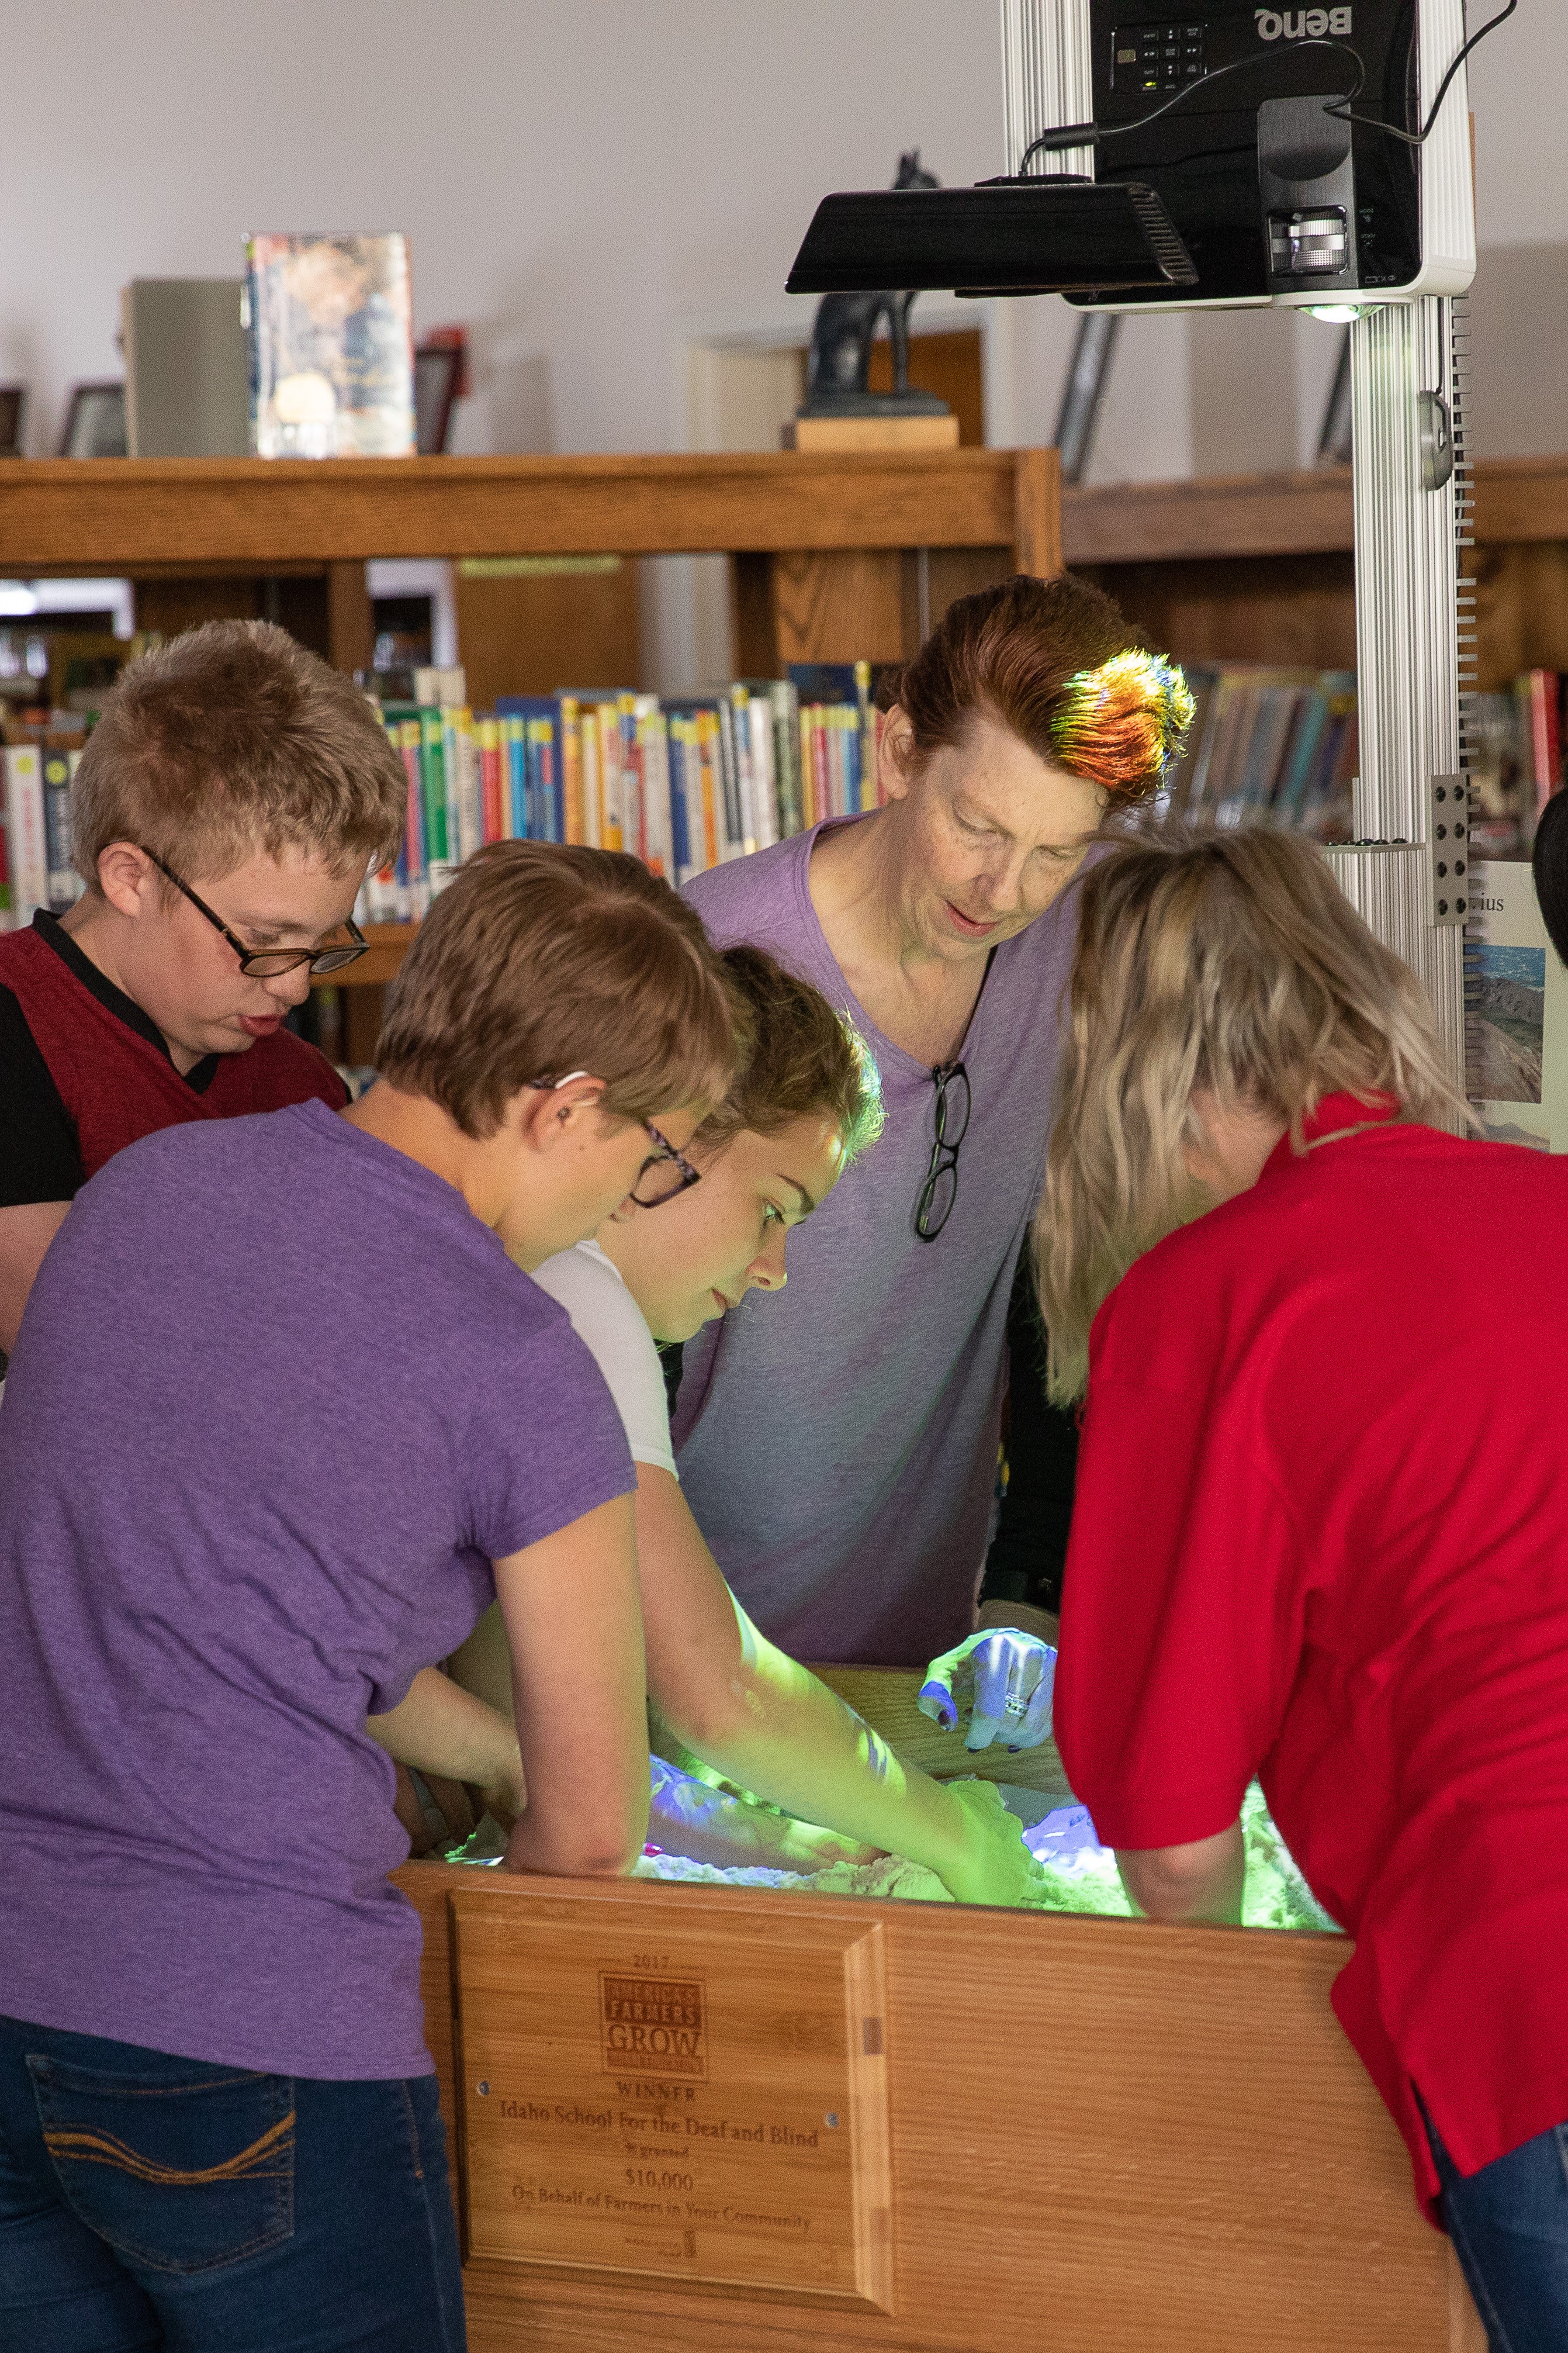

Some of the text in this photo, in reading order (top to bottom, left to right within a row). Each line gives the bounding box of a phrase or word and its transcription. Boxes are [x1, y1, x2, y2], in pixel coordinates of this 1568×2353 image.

[1254, 6, 1352, 40] BenQ
[1472, 892, 1504, 911] ius
[634, 1954, 670, 1970] 2017
[610, 2000, 697, 2024] FARMERS
[608, 2023, 703, 2057] GROW
[617, 2081, 695, 2101] WINNER
[501, 2100, 818, 2148] Idaho School For the Deaf and Blind
[625, 2167, 694, 2192] $10,000
[512, 2185, 811, 2234] On Behalf of Farmers in Your Community
